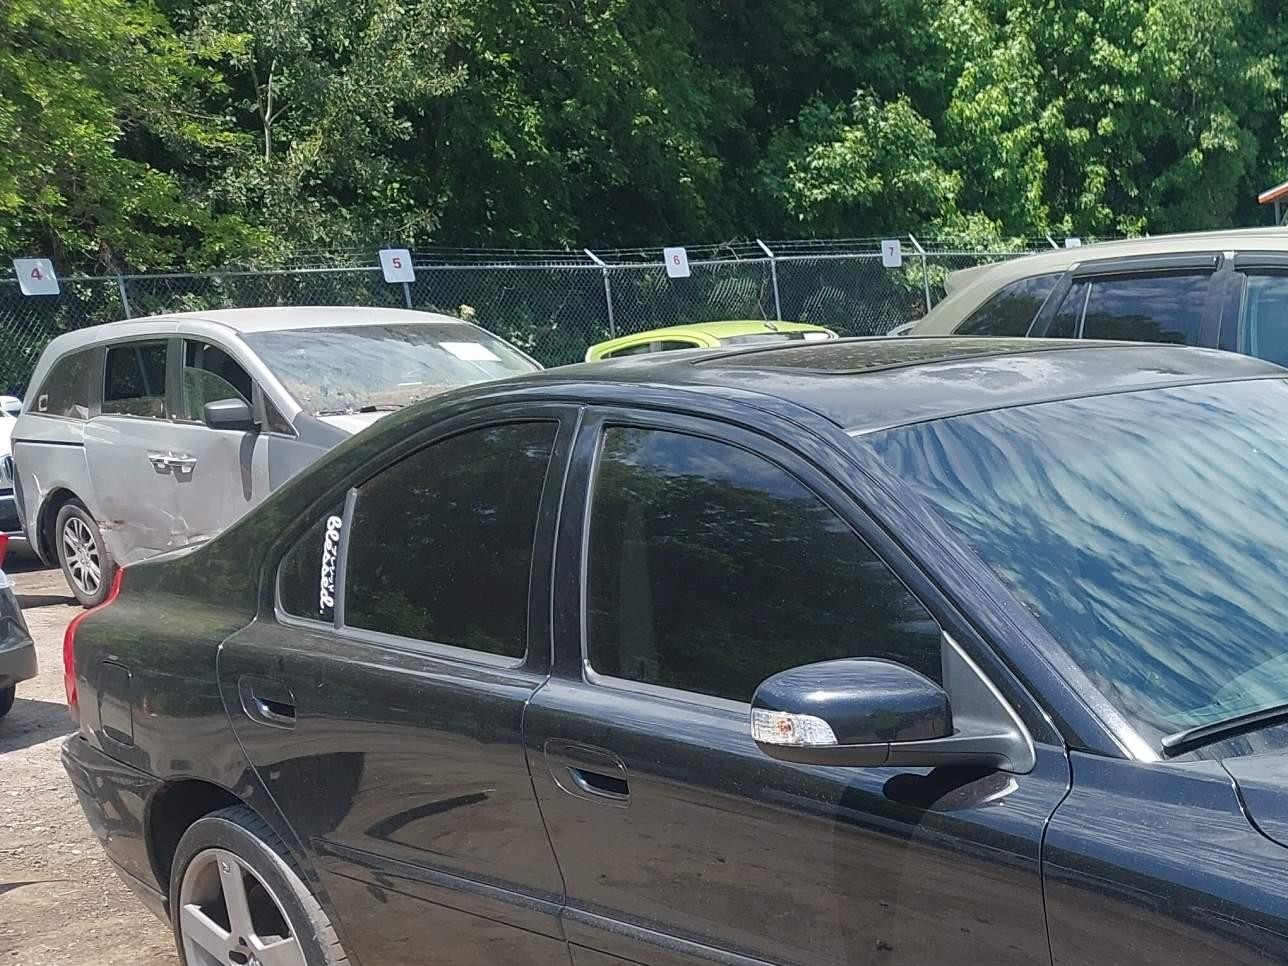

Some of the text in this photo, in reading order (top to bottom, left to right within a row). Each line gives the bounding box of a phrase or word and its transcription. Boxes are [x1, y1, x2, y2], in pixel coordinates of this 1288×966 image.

[888, 246, 895, 257] 7
[391, 257, 402, 269] 5
[672, 254, 681, 266] 6
[31, 267, 43, 281] 4
